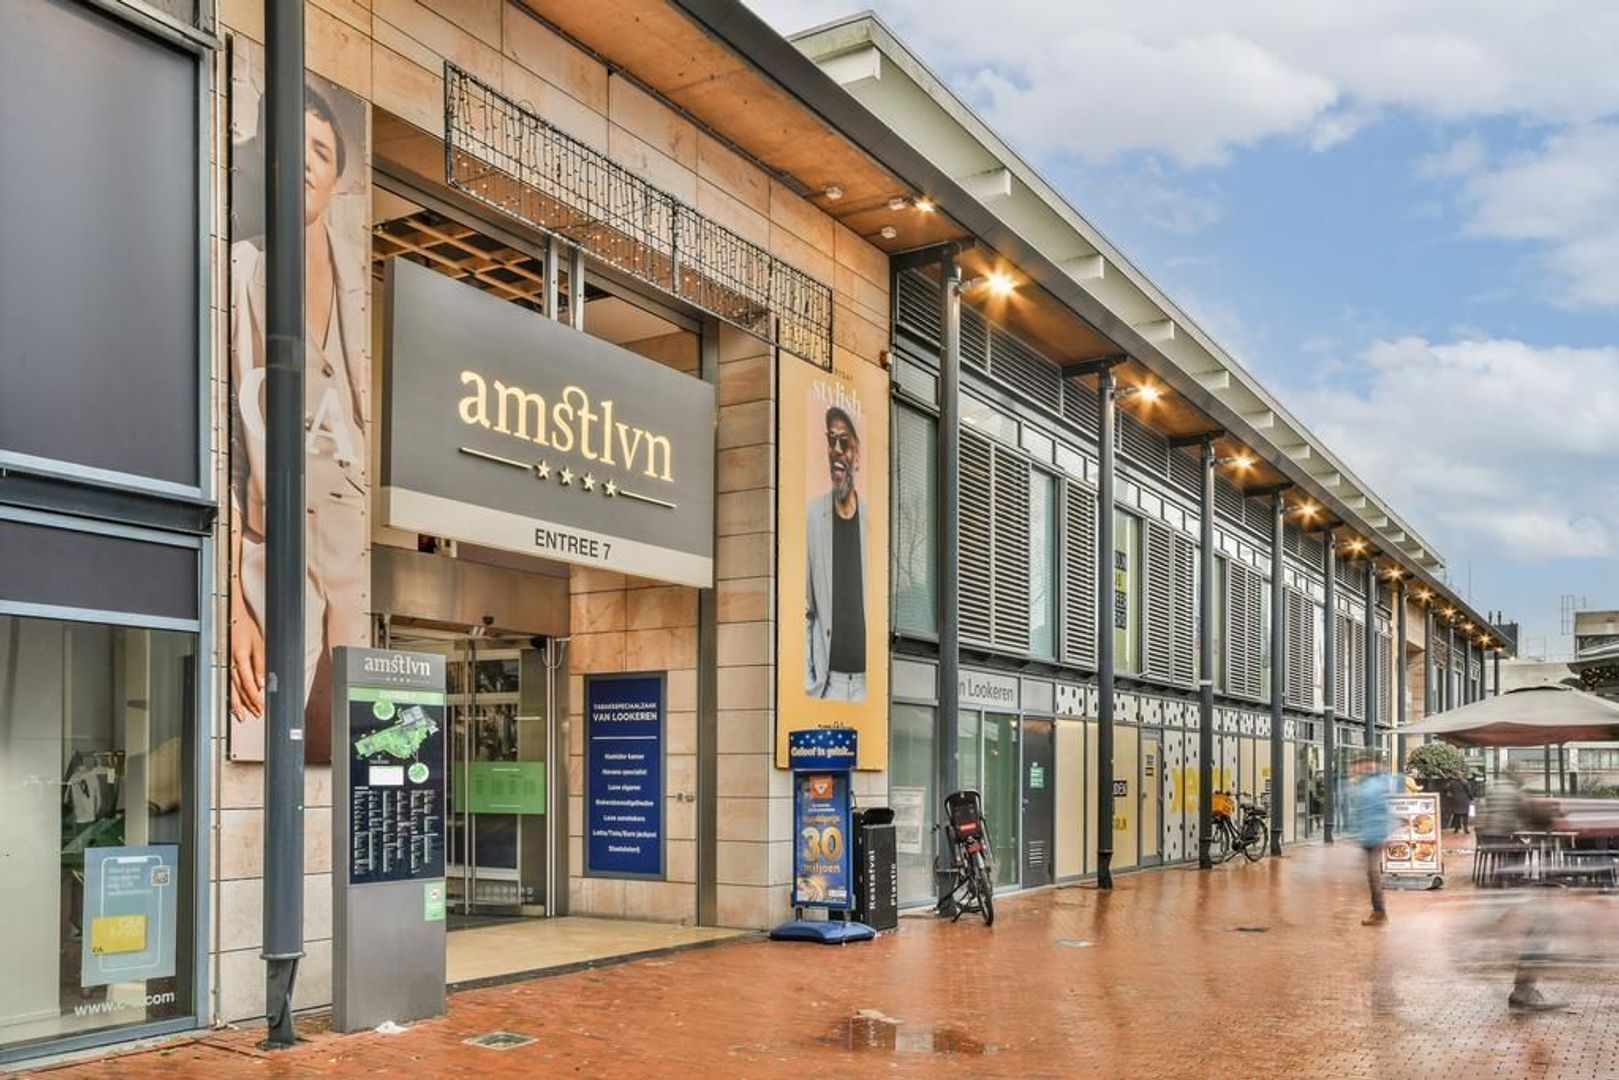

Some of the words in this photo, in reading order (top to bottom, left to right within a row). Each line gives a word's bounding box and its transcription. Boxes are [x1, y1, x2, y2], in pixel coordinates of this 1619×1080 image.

[458, 369, 675, 482] amstlvn
[535, 528, 599, 557] ENTREE
[603, 543, 611, 560] 7
[365, 654, 431, 676] amstlvn
[968, 678, 1014, 702] Lookeren
[593, 713, 610, 722] VAN
[612, 712, 658, 721] LOOKEREN
[802, 827, 844, 861] 30
